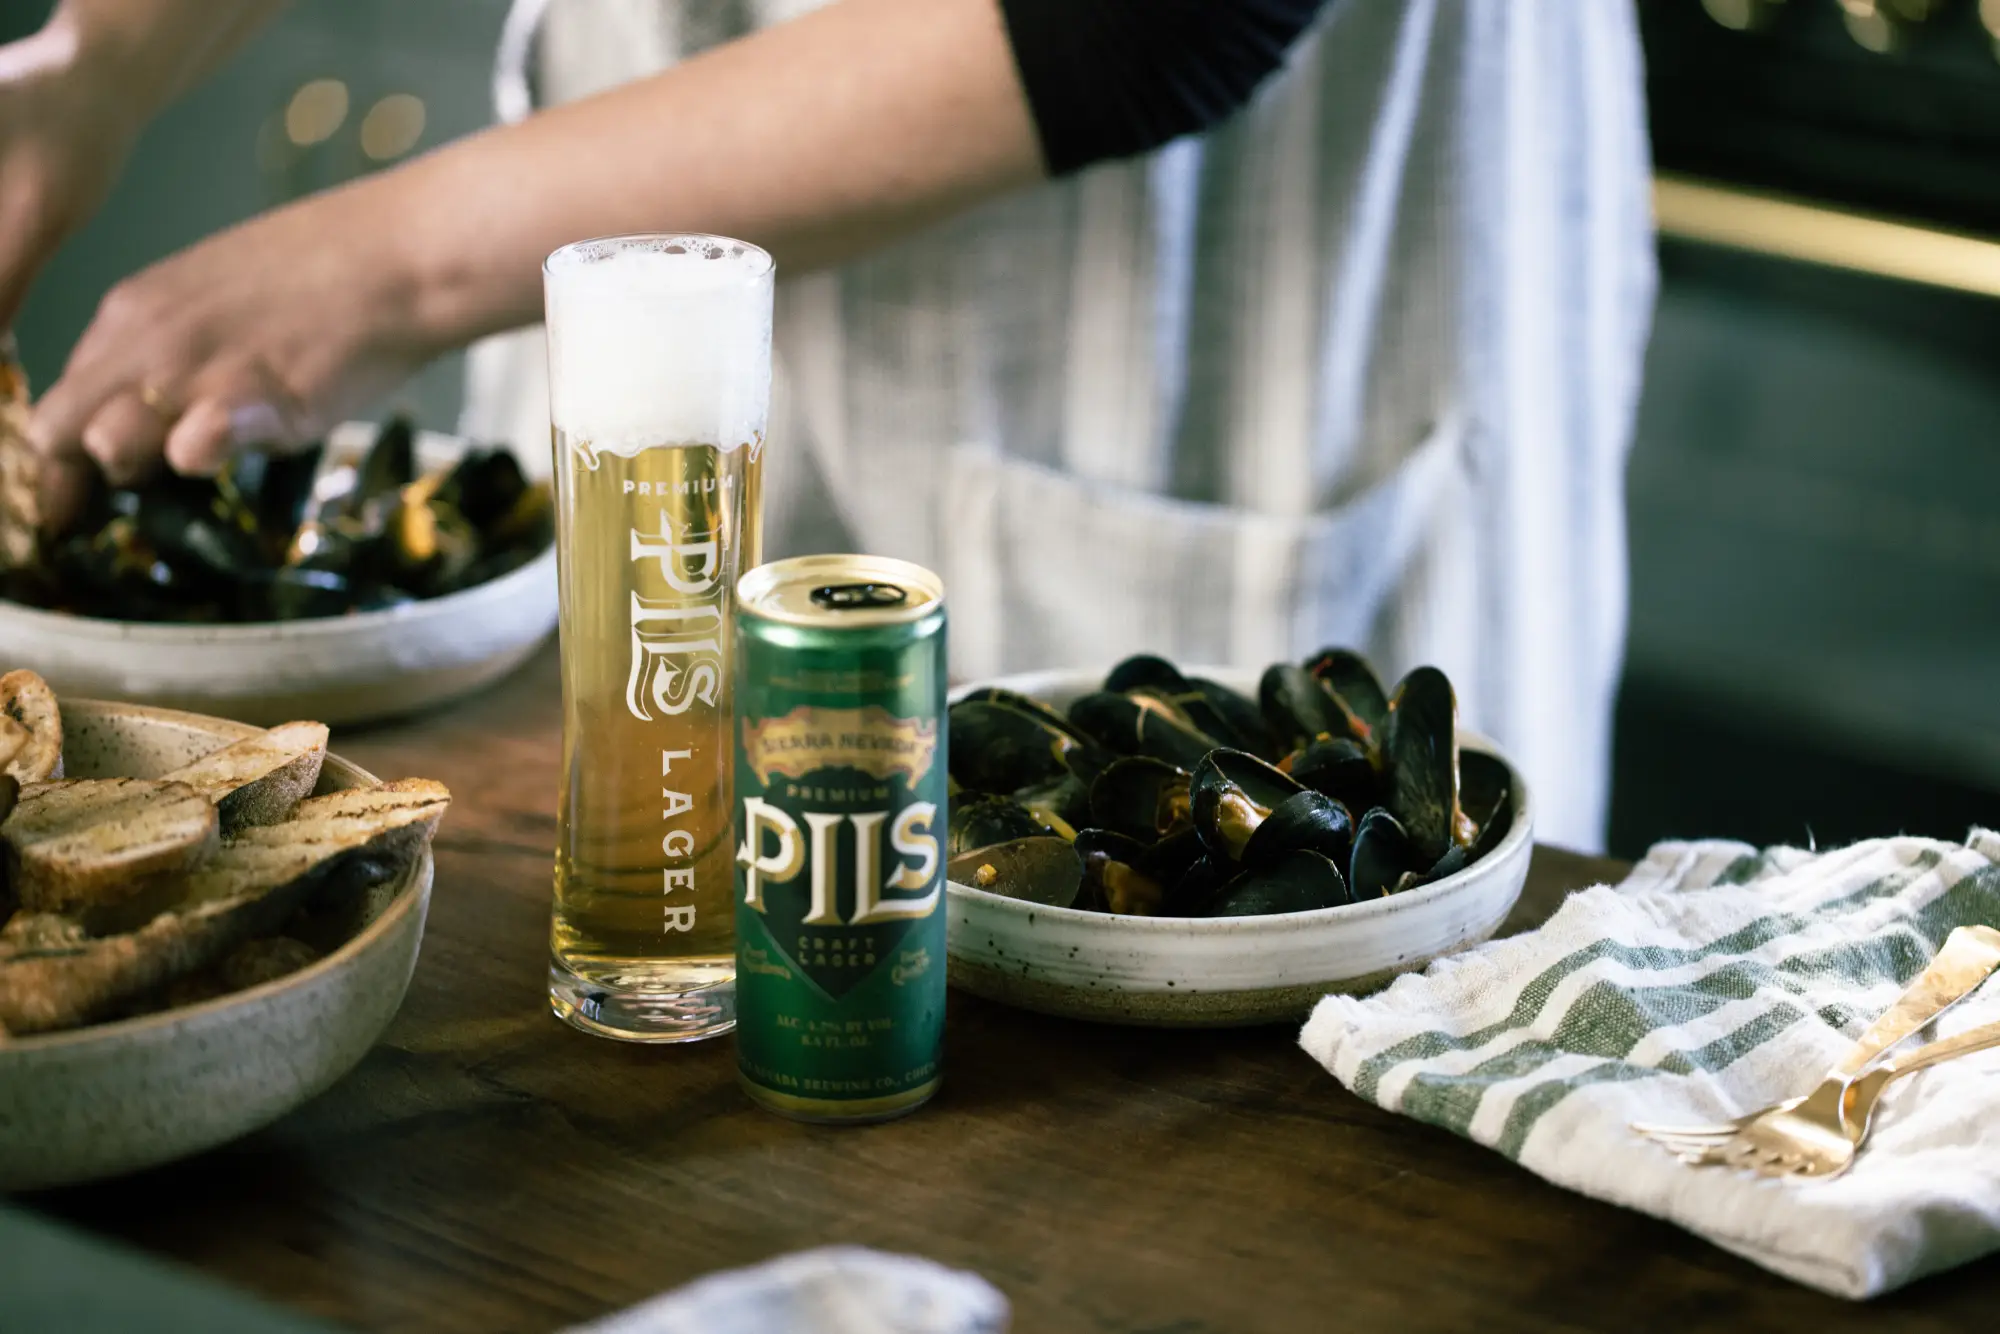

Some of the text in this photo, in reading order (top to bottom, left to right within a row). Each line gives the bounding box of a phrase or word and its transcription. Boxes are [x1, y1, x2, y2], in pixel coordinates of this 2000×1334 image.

[623, 474, 733, 496] PREMIUM
[626, 508, 729, 722] PILS
[786, 783, 890, 801] PREMIUM
[662, 748, 697, 934] LAGER
[736, 797, 942, 925] PILS
[798, 936, 876, 950] CRAFT
[798, 953, 876, 967] LAGER
[804, 1078, 871, 1091] BREWING
